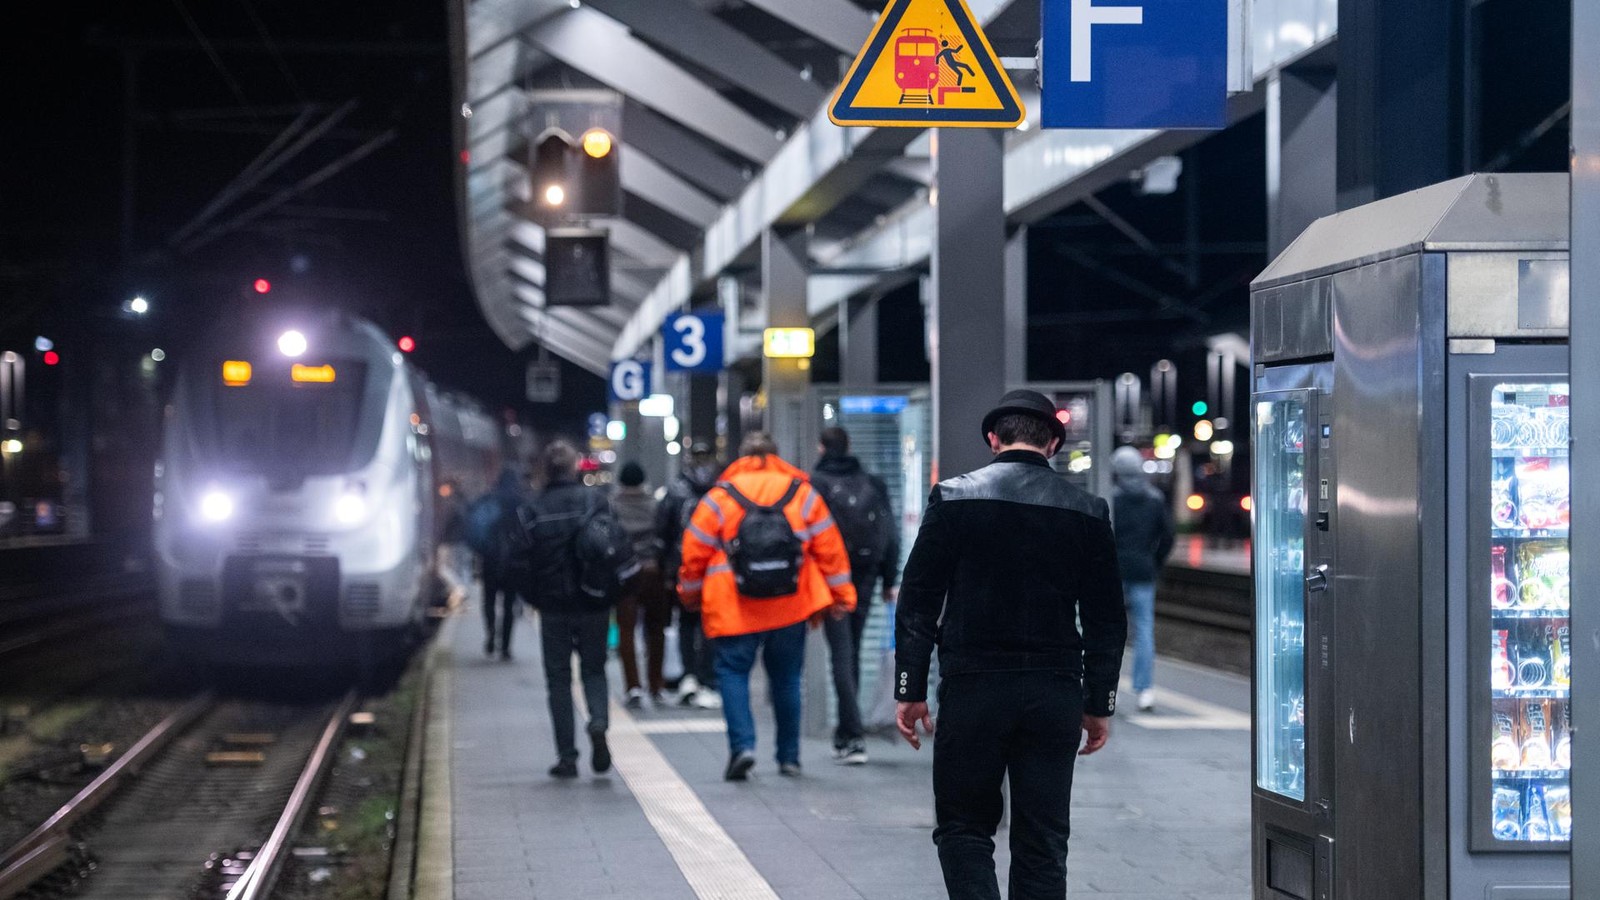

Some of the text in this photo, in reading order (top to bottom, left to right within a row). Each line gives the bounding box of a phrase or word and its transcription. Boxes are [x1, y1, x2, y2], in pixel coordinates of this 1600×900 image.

[1070, 0, 1143, 82] F
[671, 314, 707, 368] 3
[612, 359, 645, 400] G
